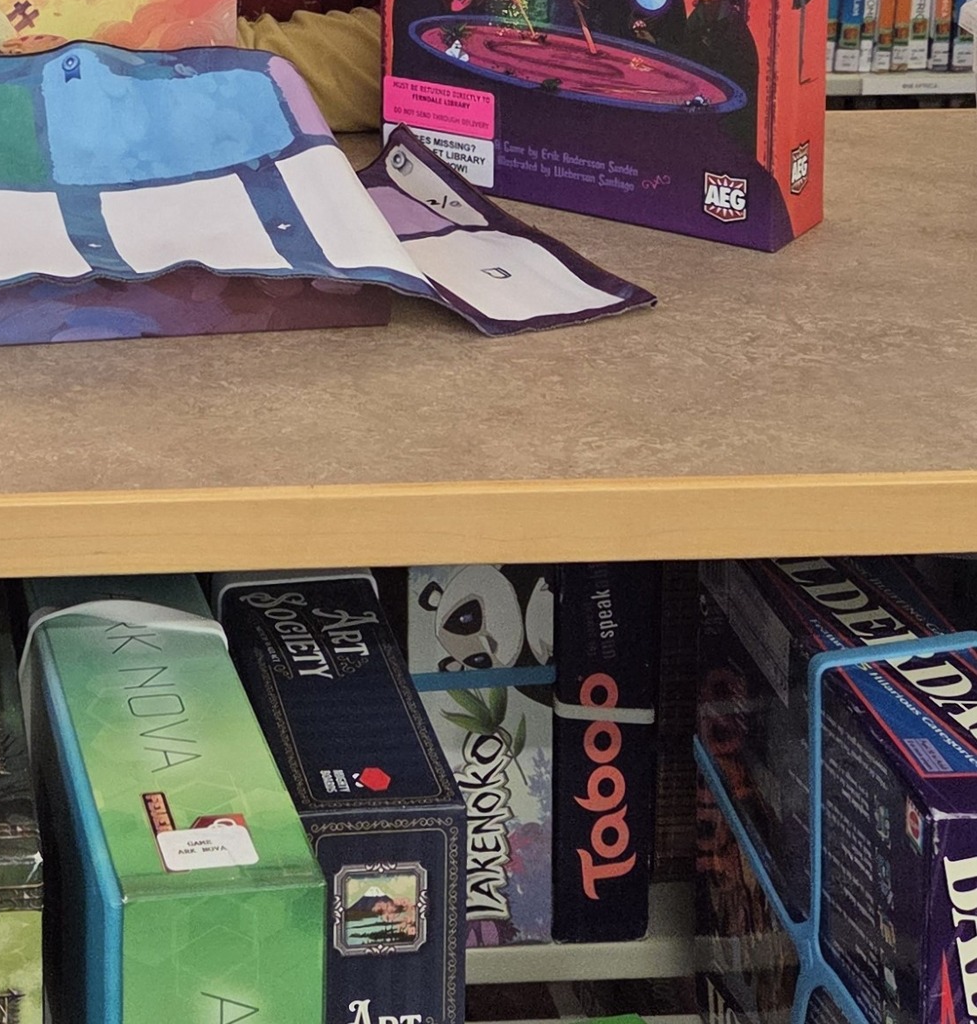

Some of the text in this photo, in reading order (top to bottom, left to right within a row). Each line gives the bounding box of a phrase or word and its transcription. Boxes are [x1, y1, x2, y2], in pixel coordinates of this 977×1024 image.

[433, 136, 477, 153] MISSING?
[445, 150, 486, 166] LIBRARY
[791, 156, 808, 180] AEG
[704, 185, 746, 211] AEG
[239, 592, 333, 680] SOCIETY
[312, 606, 380, 658] ART
[869, 672, 921, 717] Hilarious
[118, 666, 203, 774] NOVA
[574, 672, 638, 900] Taboo
[178, 847, 198, 855] ARK
[187, 840, 214, 848] GAME
